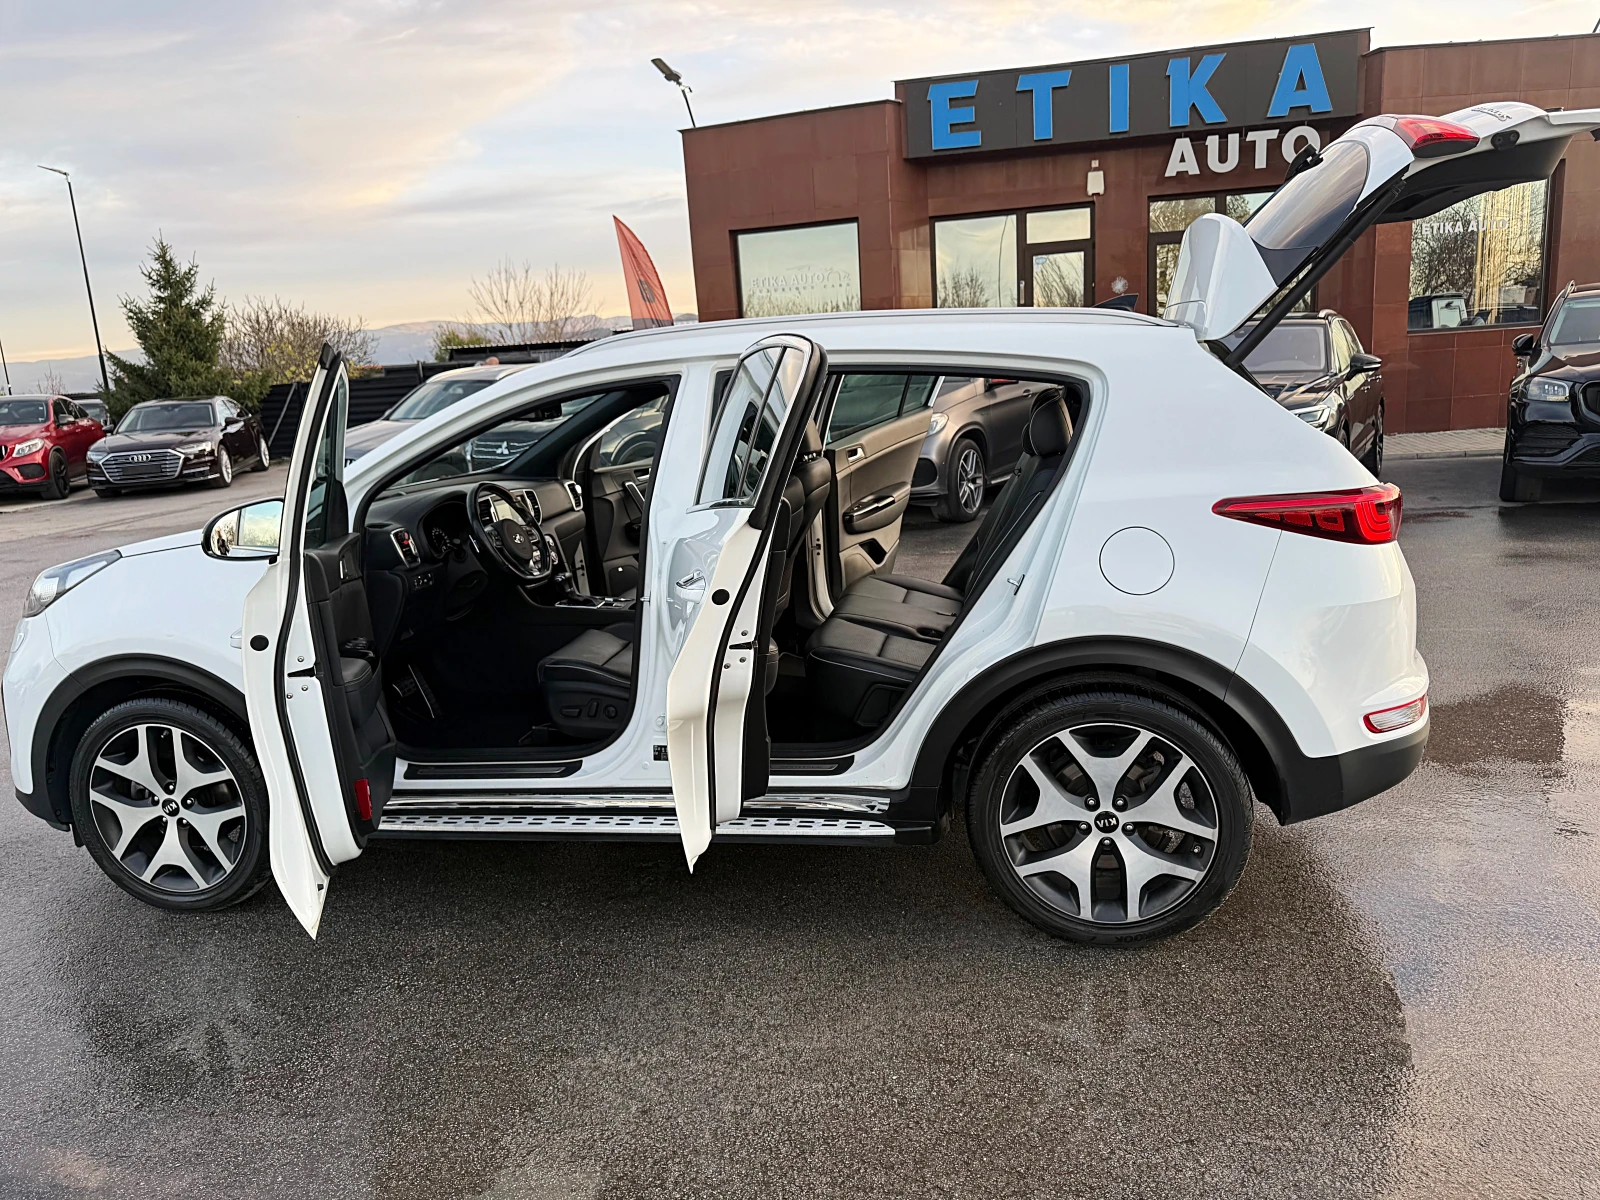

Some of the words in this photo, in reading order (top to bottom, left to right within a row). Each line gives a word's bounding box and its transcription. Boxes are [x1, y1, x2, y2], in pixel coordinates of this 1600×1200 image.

[927, 42, 1333, 150] ETIKA
[1164, 125, 1321, 177] AUTO
[1421, 220, 1464, 235] ETIKA
[1467, 218, 1508, 232] AUTO
[752, 275, 788, 288] ETIKA
[790, 271, 825, 286] AUTO
[163, 801, 178, 814] KIA
[1096, 817, 1118, 828] KIA
